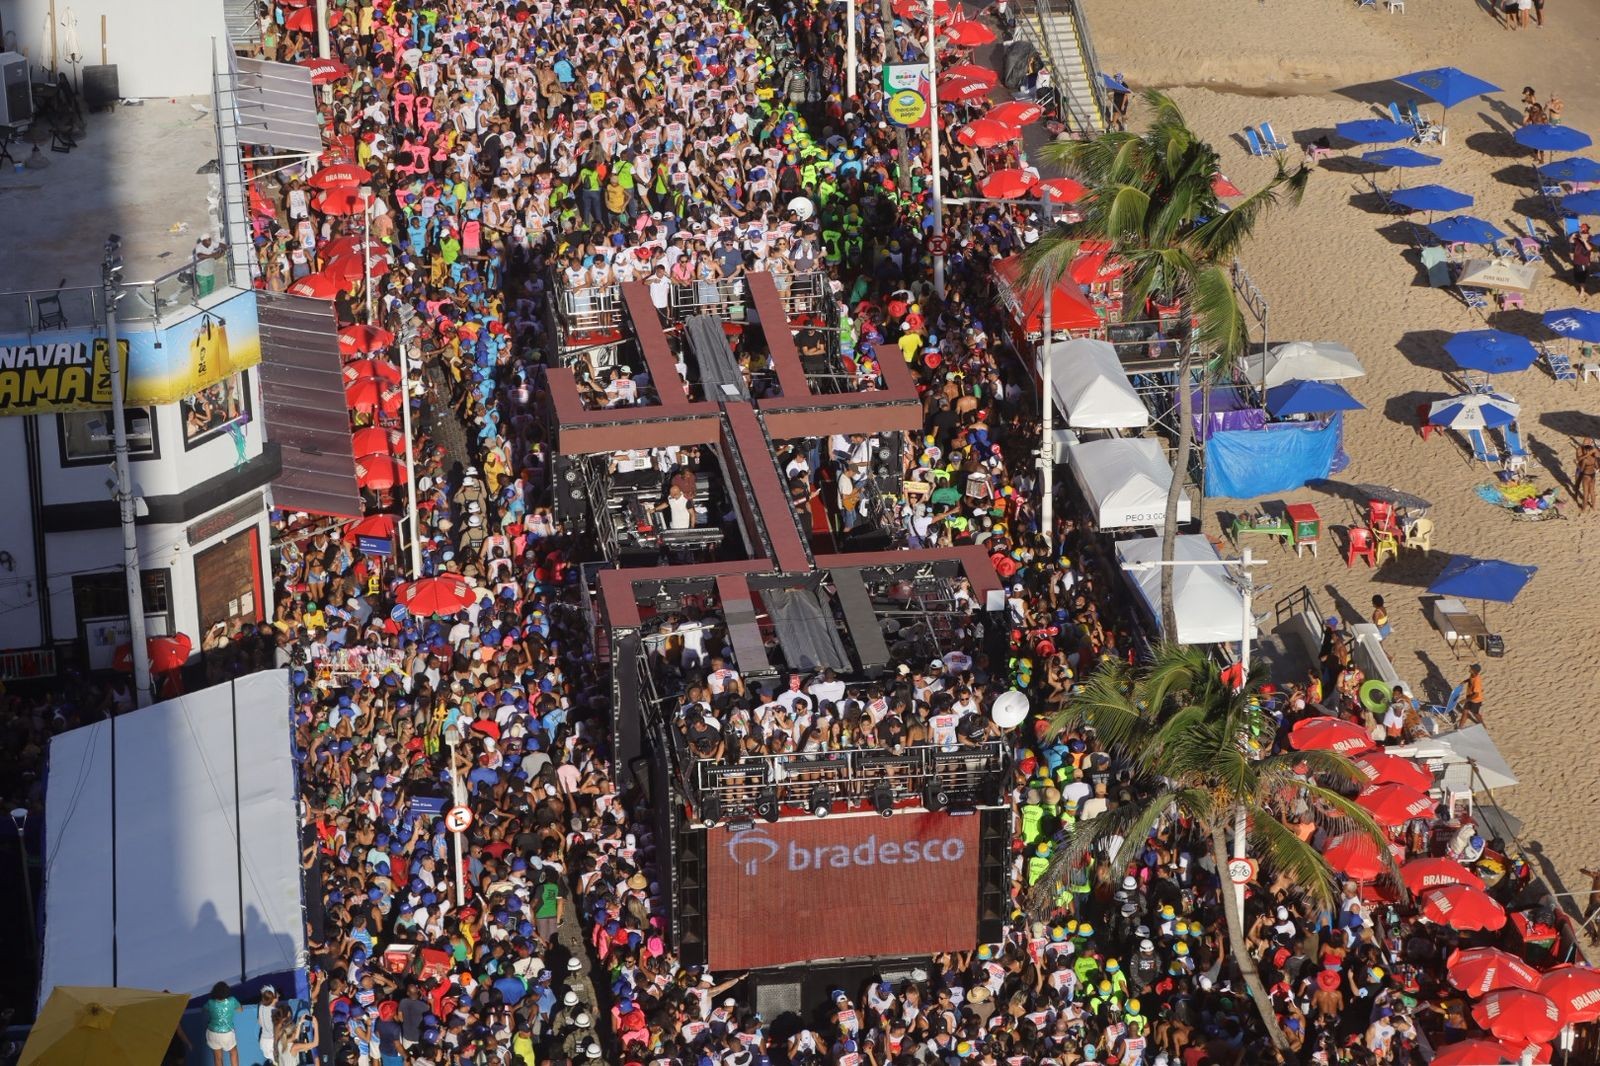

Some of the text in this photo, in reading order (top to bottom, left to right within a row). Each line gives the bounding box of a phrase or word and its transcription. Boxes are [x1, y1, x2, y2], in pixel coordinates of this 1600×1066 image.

[961, 83, 989, 94] BRAHMA
[325, 173, 353, 182] BRAHMA
[788, 834, 965, 871] bradesco
[1480, 967, 1497, 993] BRAHMA
